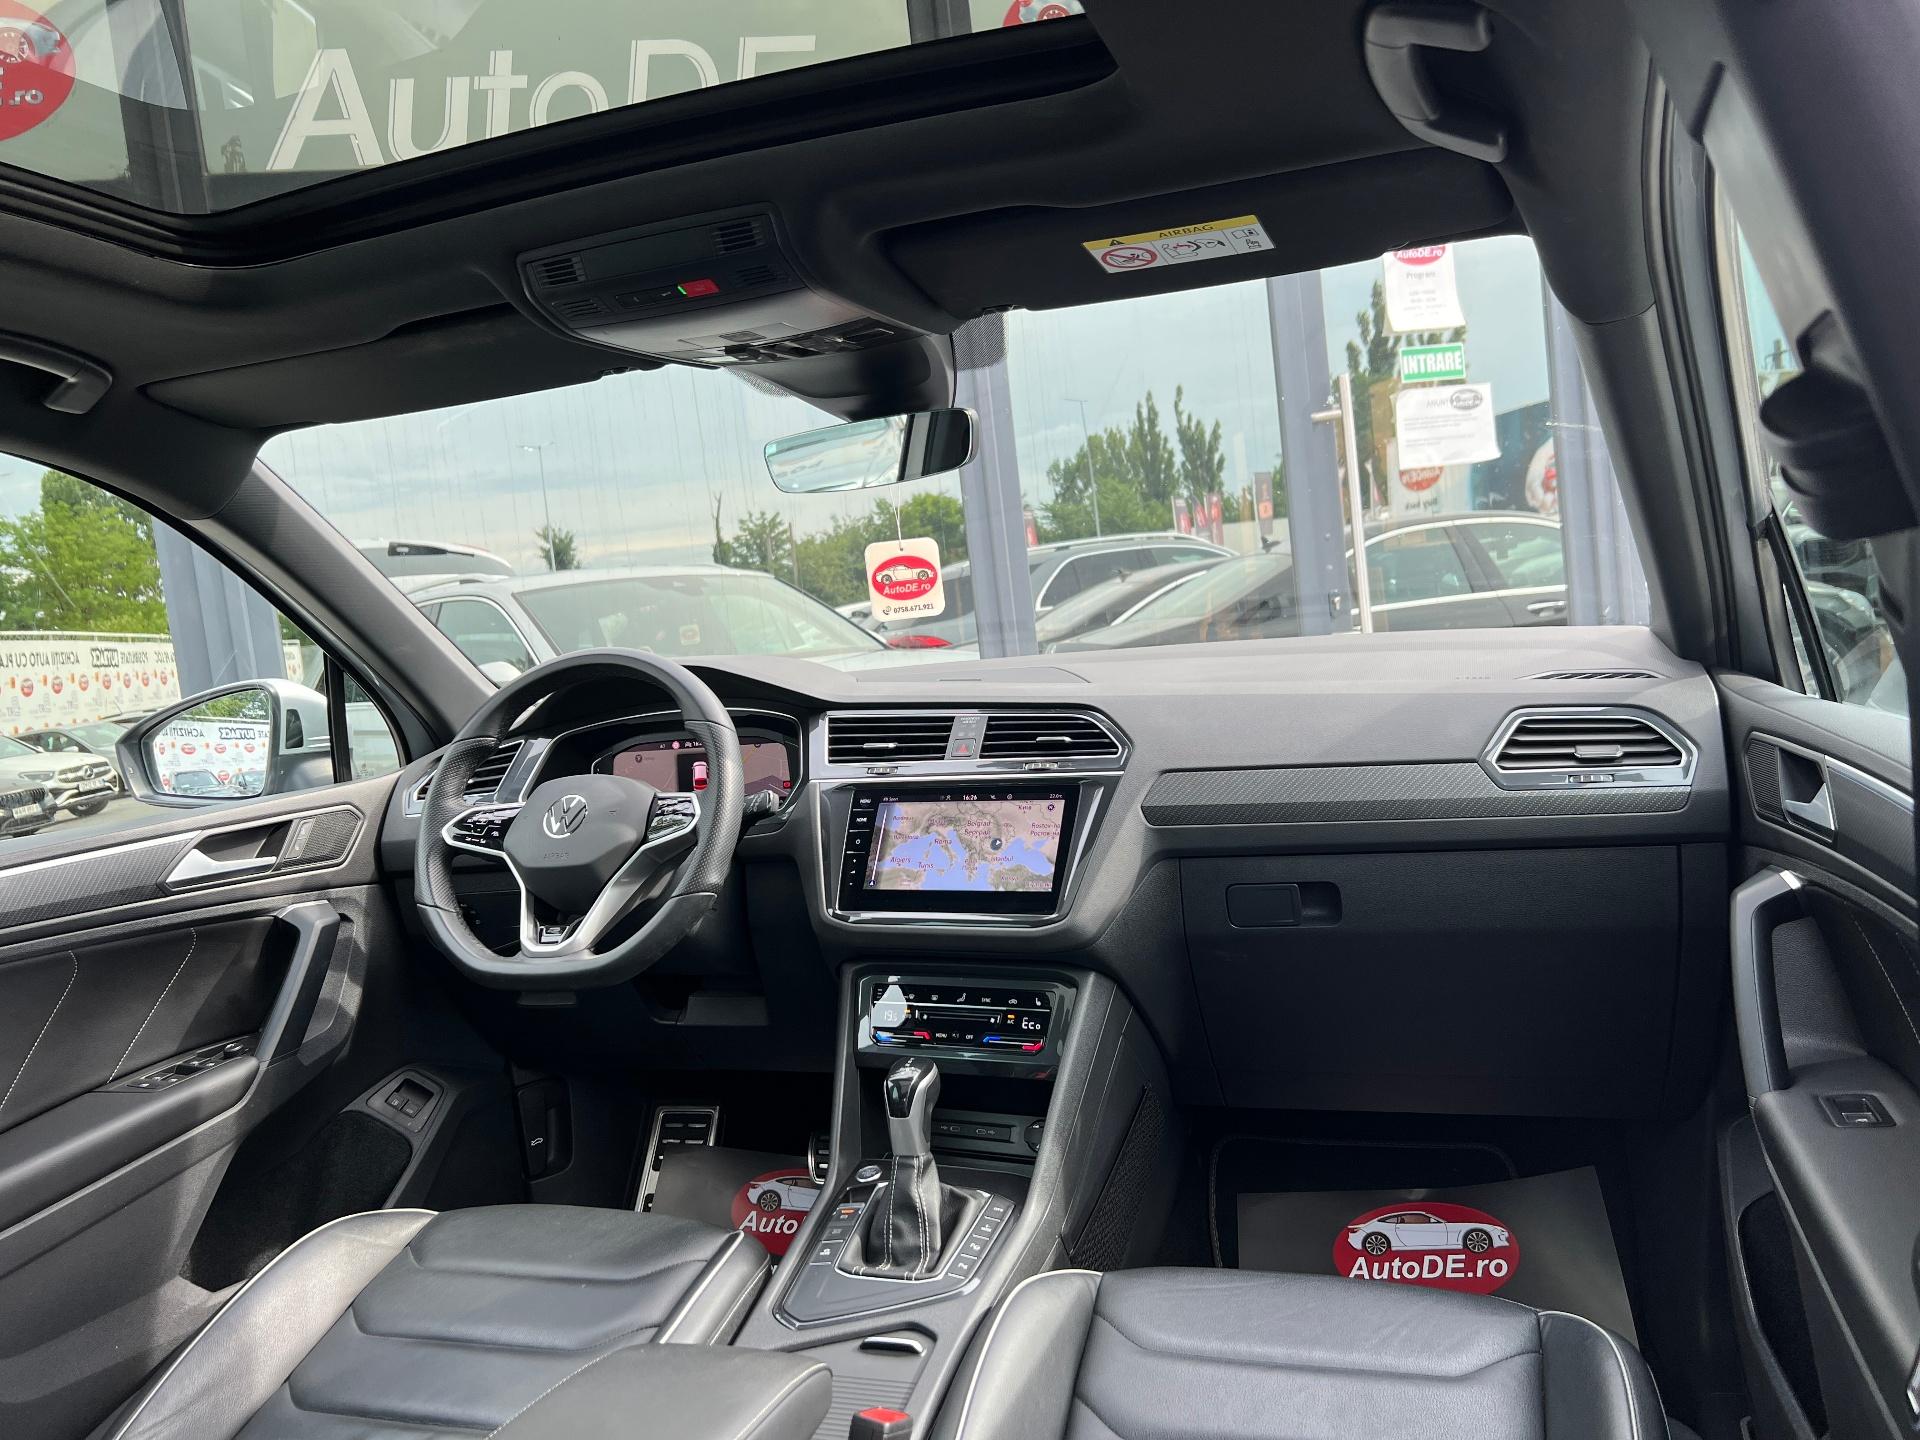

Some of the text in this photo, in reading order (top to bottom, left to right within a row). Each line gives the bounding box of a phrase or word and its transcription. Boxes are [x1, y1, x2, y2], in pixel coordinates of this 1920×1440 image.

[1159, 224, 1214, 239] AIRBAG
[1402, 351, 1463, 375] INTRARE
[883, 583, 931, 595] AutoDE.ro
[893, 603, 934, 614] 0758.671.921
[739, 1210, 806, 1235] Auto
[1349, 1254, 1508, 1280] AutoDE.ro
